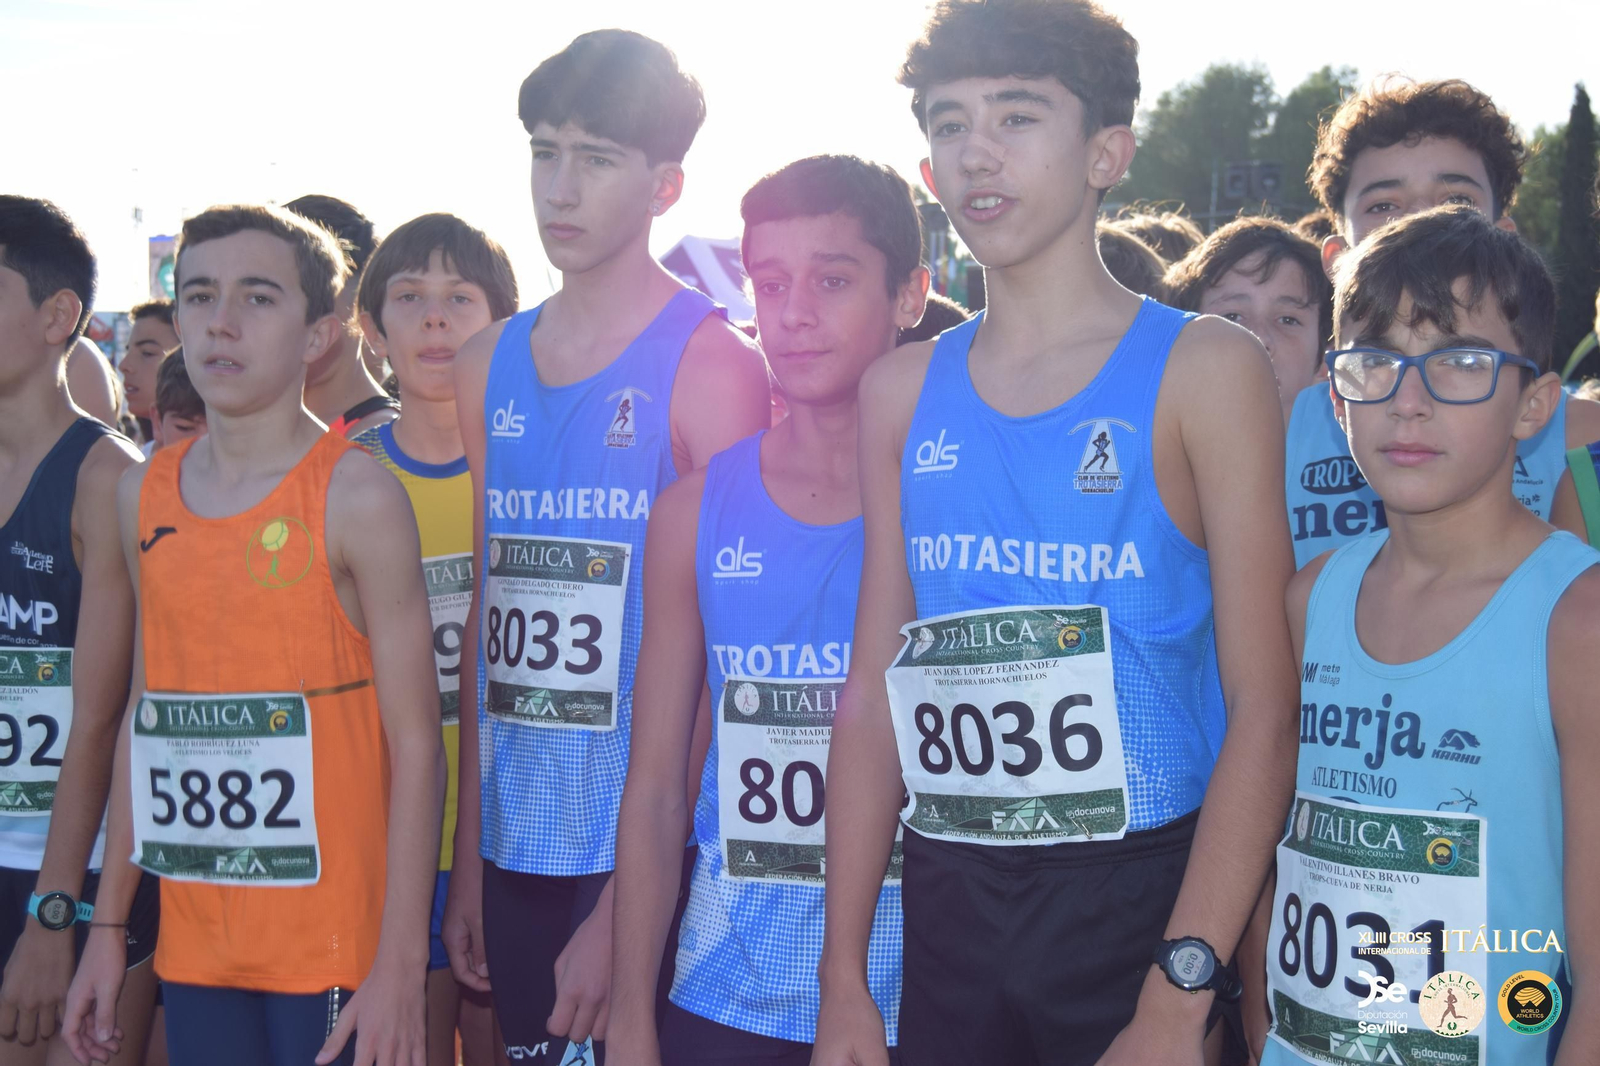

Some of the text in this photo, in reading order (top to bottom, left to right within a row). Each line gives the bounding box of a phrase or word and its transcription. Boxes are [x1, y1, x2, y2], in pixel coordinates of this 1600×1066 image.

[491, 399, 526, 438] als
[913, 428, 960, 475] als
[1073, 480, 1123, 489] TROTASIERRA
[506, 541, 575, 568] ITÁLICA
[712, 535, 763, 578] als
[910, 533, 1145, 583] TROTASIERRA
[520, 579, 551, 589] DELGADO
[551, 581, 584, 592] CUBERO
[452, 593, 467, 602] GIL
[529, 589, 576, 599] HORNACHUELOS
[487, 605, 603, 675] 8033
[938, 618, 1038, 650] ITÁLICA
[433, 621, 465, 676] 9
[981, 647, 1005, 655] CROSS
[1005, 644, 1039, 653] COUNTRY
[923, 659, 1060, 677] JUAN JOSE LOPEZ FERNANDEZ
[1321, 664, 1341, 673] metro
[934, 672, 1048, 687] TROTASIERRA HORNACHUELOS
[1319, 674, 1340, 687] Málaga
[167, 701, 255, 726] ITÁLICA
[571, 702, 605, 711] docunova
[766, 728, 797, 737] JAVIER
[914, 693, 1103, 777] 8036
[1300, 692, 1426, 771] nerja
[166, 738, 260, 748] PABLO RODRÍGUEZ LUNA
[769, 737, 820, 746] TROTASIERRA
[1431, 748, 1482, 765] KARHU
[1311, 766, 1398, 799] ATLETISMO
[150, 767, 301, 829] 5882
[738, 757, 826, 827] 80
[1074, 805, 1116, 817] docunova
[979, 831, 1013, 841] ANDALUZA
[1014, 833, 1023, 841] DE
[1026, 831, 1068, 840] ATLETISMO
[1310, 809, 1405, 851] ITÁLICA
[278, 856, 310, 866] docunova
[1344, 848, 1365, 856] CROSS
[1366, 850, 1406, 860] COUNTRY
[765, 873, 802, 881] FEDERACIÓN
[1299, 855, 1420, 885] VALENTINO ILLANES BRAVO
[1350, 881, 1362, 890] DE
[1363, 883, 1393, 894] NERJA
[1278, 892, 1445, 1004] 8031
[1421, 1047, 1467, 1061] docunova
